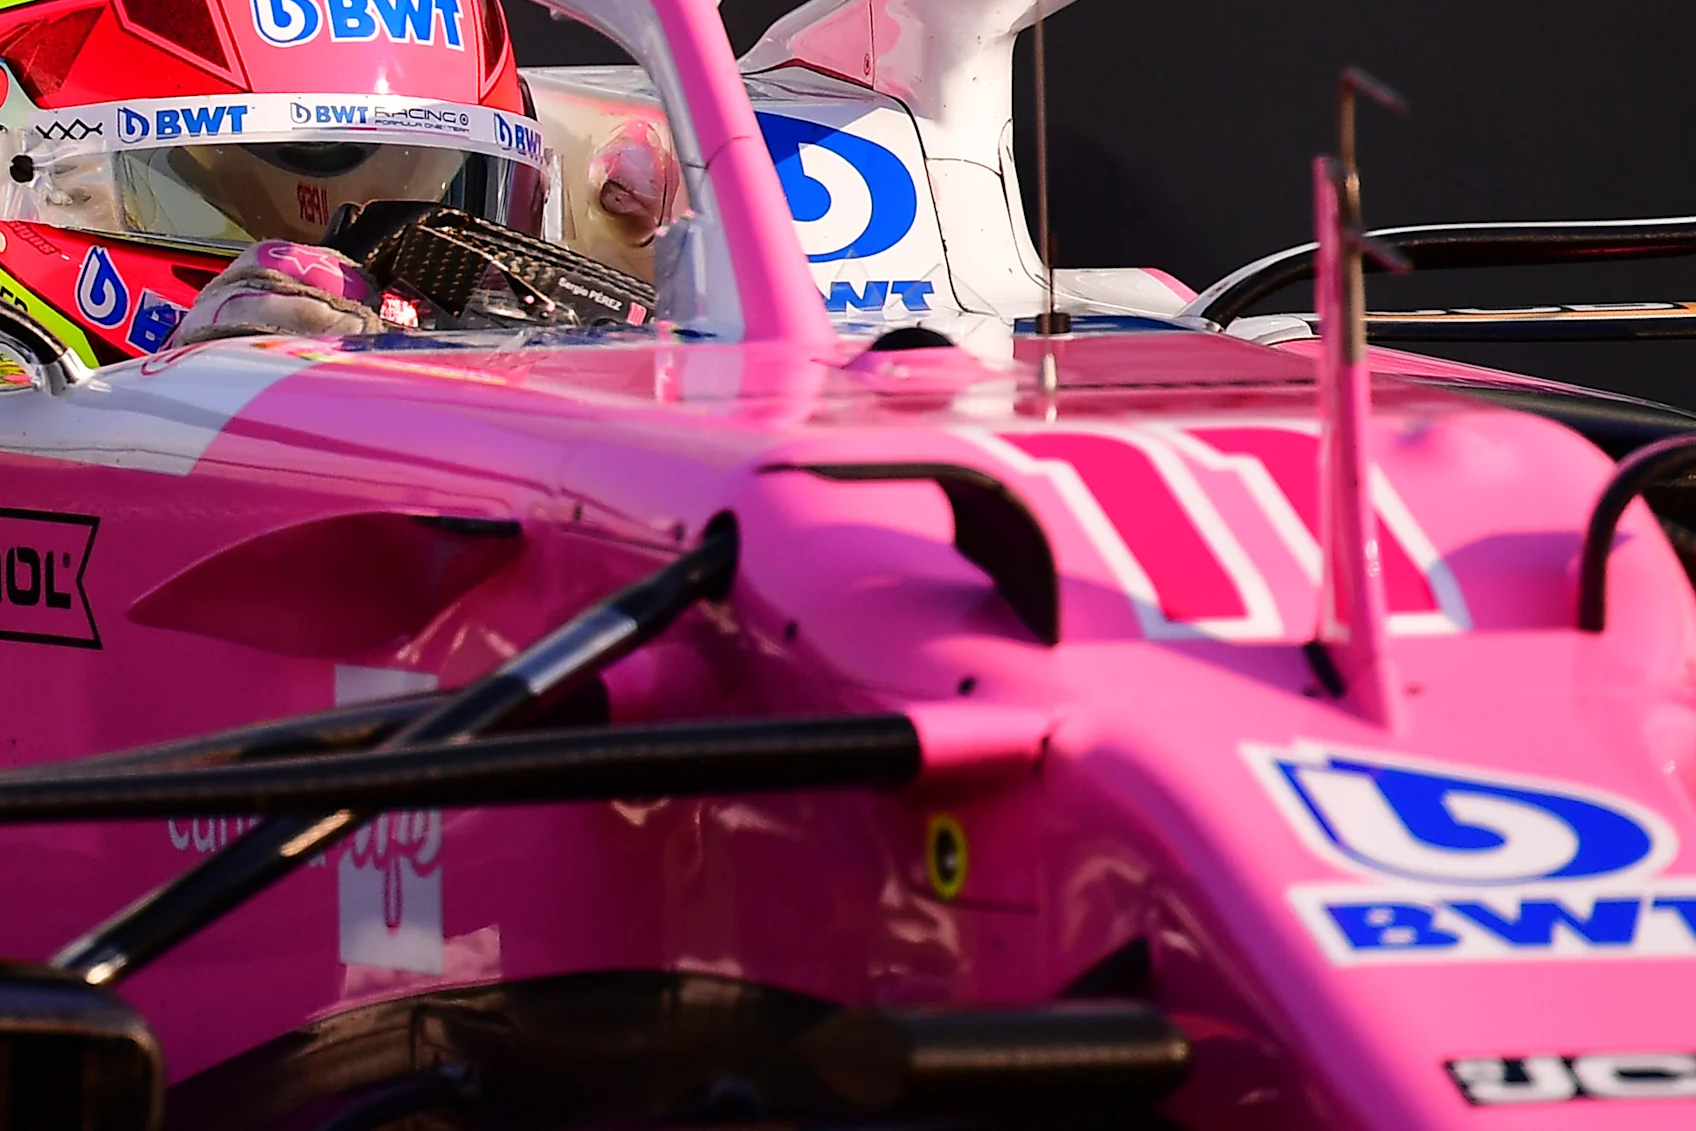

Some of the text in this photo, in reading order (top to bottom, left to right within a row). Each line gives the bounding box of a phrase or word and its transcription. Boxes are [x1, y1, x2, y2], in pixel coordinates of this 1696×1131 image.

[155, 105, 248, 140] BWT
[315, 105, 457, 124] BWT RACING
[558, 276, 589, 297] Sergio
[824, 280, 936, 312] WT
[1450, 1053, 1696, 1106] JC
